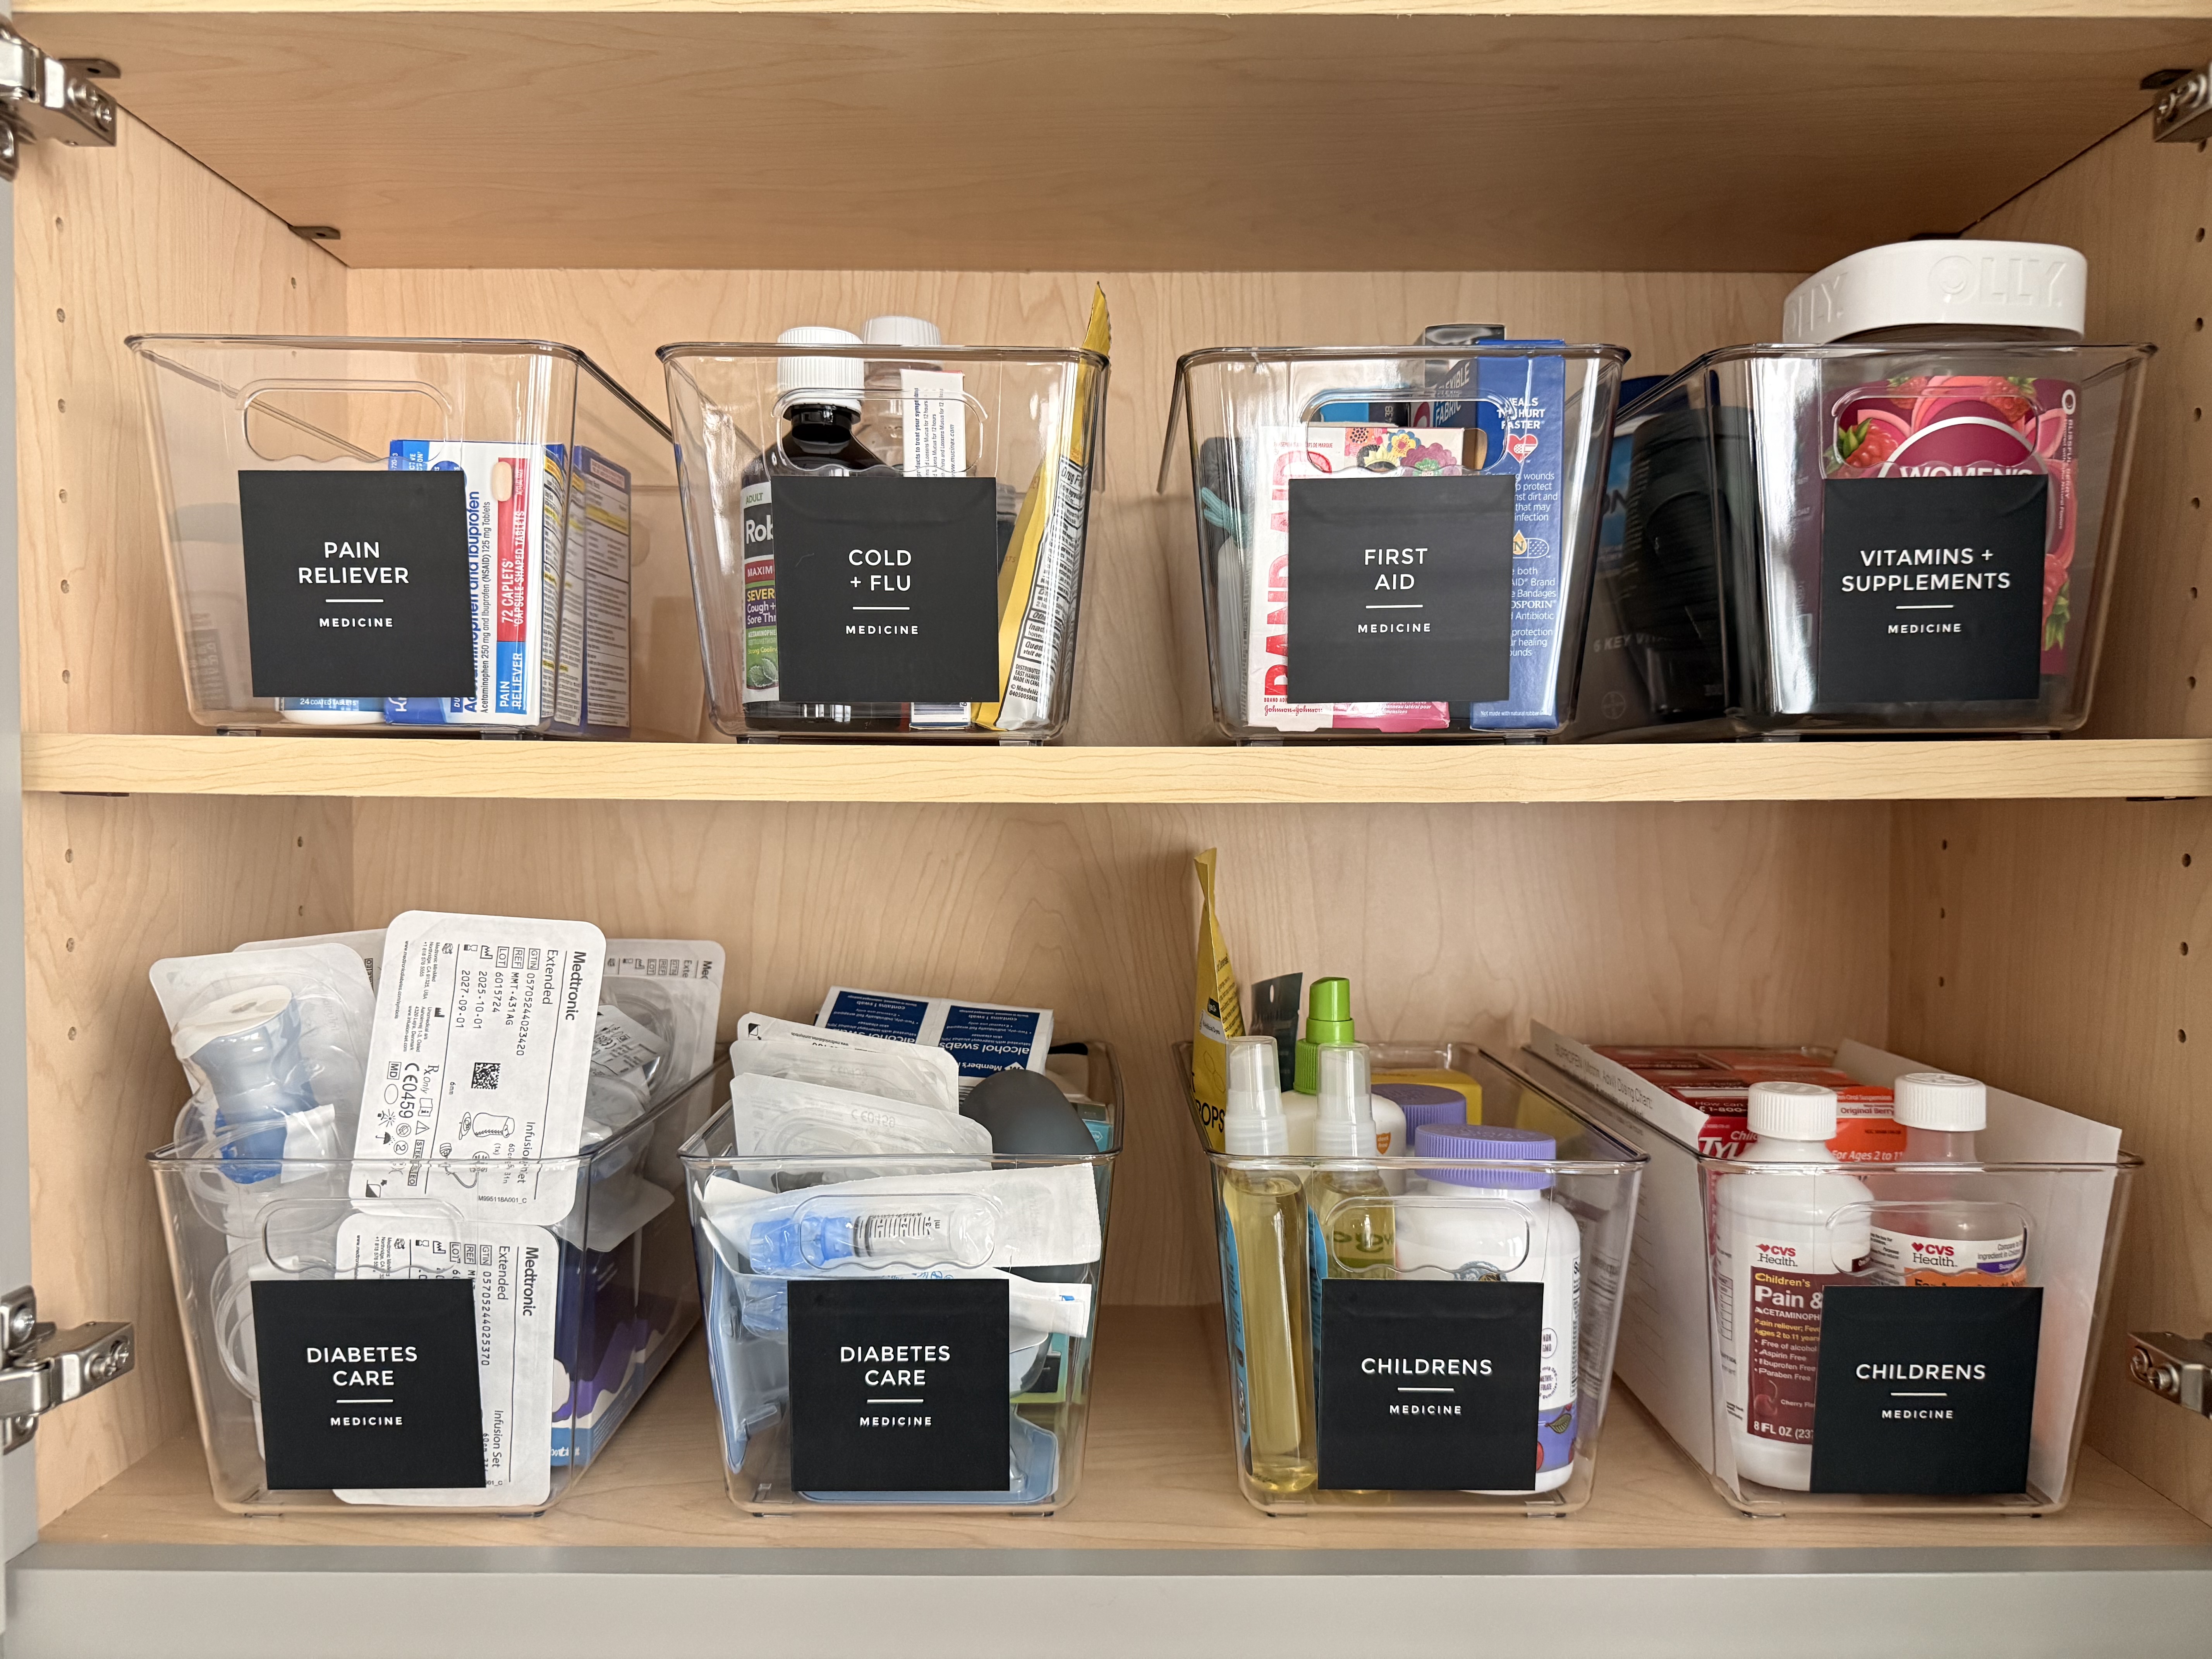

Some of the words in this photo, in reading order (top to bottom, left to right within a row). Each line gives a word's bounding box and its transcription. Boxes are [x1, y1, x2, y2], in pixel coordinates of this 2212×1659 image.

[1518, 409, 1546, 418] HURT
[1501, 420, 1540, 429] FASTER
[1523, 472, 1555, 480] wounds
[1523, 483, 1552, 492] protect
[746, 493, 764, 505] ADULT
[1528, 492, 1542, 500] dirt
[1543, 492, 1558, 501] and
[482, 501, 490, 526] Tablets
[1533, 504, 1551, 512] may
[1515, 513, 1549, 521] infection
[484, 527, 492, 538] mg
[325, 542, 380, 558] PAIN
[1365, 548, 1428, 565] FIRST
[848, 550, 912, 566] COLD
[1860, 548, 1973, 567] VITAMINS
[1982, 550, 1993, 561] +
[482, 555, 491, 582] (NSAID)
[747, 565, 773, 577] MAXIM
[1518, 567, 1537, 575] both
[299, 567, 409, 584] RELIEVER
[1375, 574, 1415, 590] AID
[1531, 578, 1555, 586] Brand
[850, 576, 861, 588] +
[871, 575, 911, 591] FLU
[1841, 573, 2010, 592] SUPPLEMENTS
[1518, 589, 1556, 598] Bandages
[481, 584, 491, 617] Ibuprofen
[747, 601, 769, 615] Cough
[770, 602, 776, 610] +
[319, 618, 393, 627] MEDICINE
[501, 610, 514, 623] 72
[747, 615, 762, 625] Sore
[846, 625, 919, 634] MEDICINE
[1358, 623, 1431, 633] MEDICINE
[1512, 628, 1553, 637] protection
[1888, 623, 1961, 634] MEDICINE
[483, 632, 491, 644] mg
[1518, 638, 1547, 647] healing
[1015, 664, 1041, 675] DISTRIBUTED
[480, 660, 490, 713] Acetaminophen
[512, 653, 523, 710] RELIEVER
[500, 681, 510, 707] PAIN
[514, 950, 522, 967] REF
[542, 950, 559, 1004] Extended
[565, 951, 587, 1020] Medtronic
[455, 970, 471, 1028] 2027-09-01
[492, 972, 504, 1013] 6015724
[473, 970, 488, 1029] 2025-10-01
[517, 973, 535, 1056] 05705244023420
[939, 1042, 980, 1051] swabs
[982, 1046, 1030, 1055] alcohol
[389, 1063, 399, 1078] MD
[962, 1062, 1002, 1072] Member's
[420, 1077, 431, 1094] Only
[493, 1143, 501, 1155] (1x)
[1832, 1150, 1848, 1159] For
[1848, 1151, 1872, 1161] Ages
[1873, 1151, 1880, 1160] 2
[1881, 1152, 1891, 1160] to
[478, 1195, 527, 1204] M995118A001_C
[452, 1244, 461, 1263] LOT
[1771, 1245, 1796, 1257] CVS
[1925, 1243, 1954, 1256] CVS
[497, 1245, 510, 1300] Extended
[523, 1246, 539, 1316] Medtronic
[1755, 1273, 1811, 1288] Children's
[1755, 1285, 1804, 1309] Pain
[1810, 1291, 1822, 1309] &
[481, 1271, 491, 1365] 05705244025370
[1755, 1306, 1820, 1321] ACETAMINOPH
[1754, 1318, 1773, 1327] Pain
[1543, 1334, 1551, 1342] NON
[1761, 1340, 1779, 1348] Free
[1790, 1344, 1817, 1352] alcohol
[307, 1347, 417, 1363] DIABETES
[840, 1346, 950, 1362] DIABETES
[1759, 1348, 1788, 1359] Aspirin
[1790, 1353, 1807, 1361] Free
[1362, 1358, 1492, 1375] CHILDRENS
[1759, 1358, 1797, 1370] Ibuprofen
[1799, 1364, 1816, 1372] Free
[333, 1370, 394, 1386] CARE
[865, 1370, 926, 1386] CARE
[1759, 1368, 1793, 1379] Paraben
[1794, 1373, 1811, 1381] Free
[1856, 1364, 1985, 1380] CHILDRENS
[1389, 1405, 1462, 1414] MEDICINE
[1781, 1399, 1802, 1408] Cherry
[1882, 1410, 1953, 1419] MEDICINE
[331, 1417, 403, 1426] MEDICINE
[860, 1417, 932, 1426] MEDICINE
[493, 1410, 504, 1449] Infusion
[1753, 1421, 1760, 1431] 8
[1761, 1422, 1776, 1434] FL
[1778, 1427, 1793, 1437] OZ
[492, 1452, 502, 1468] Set
